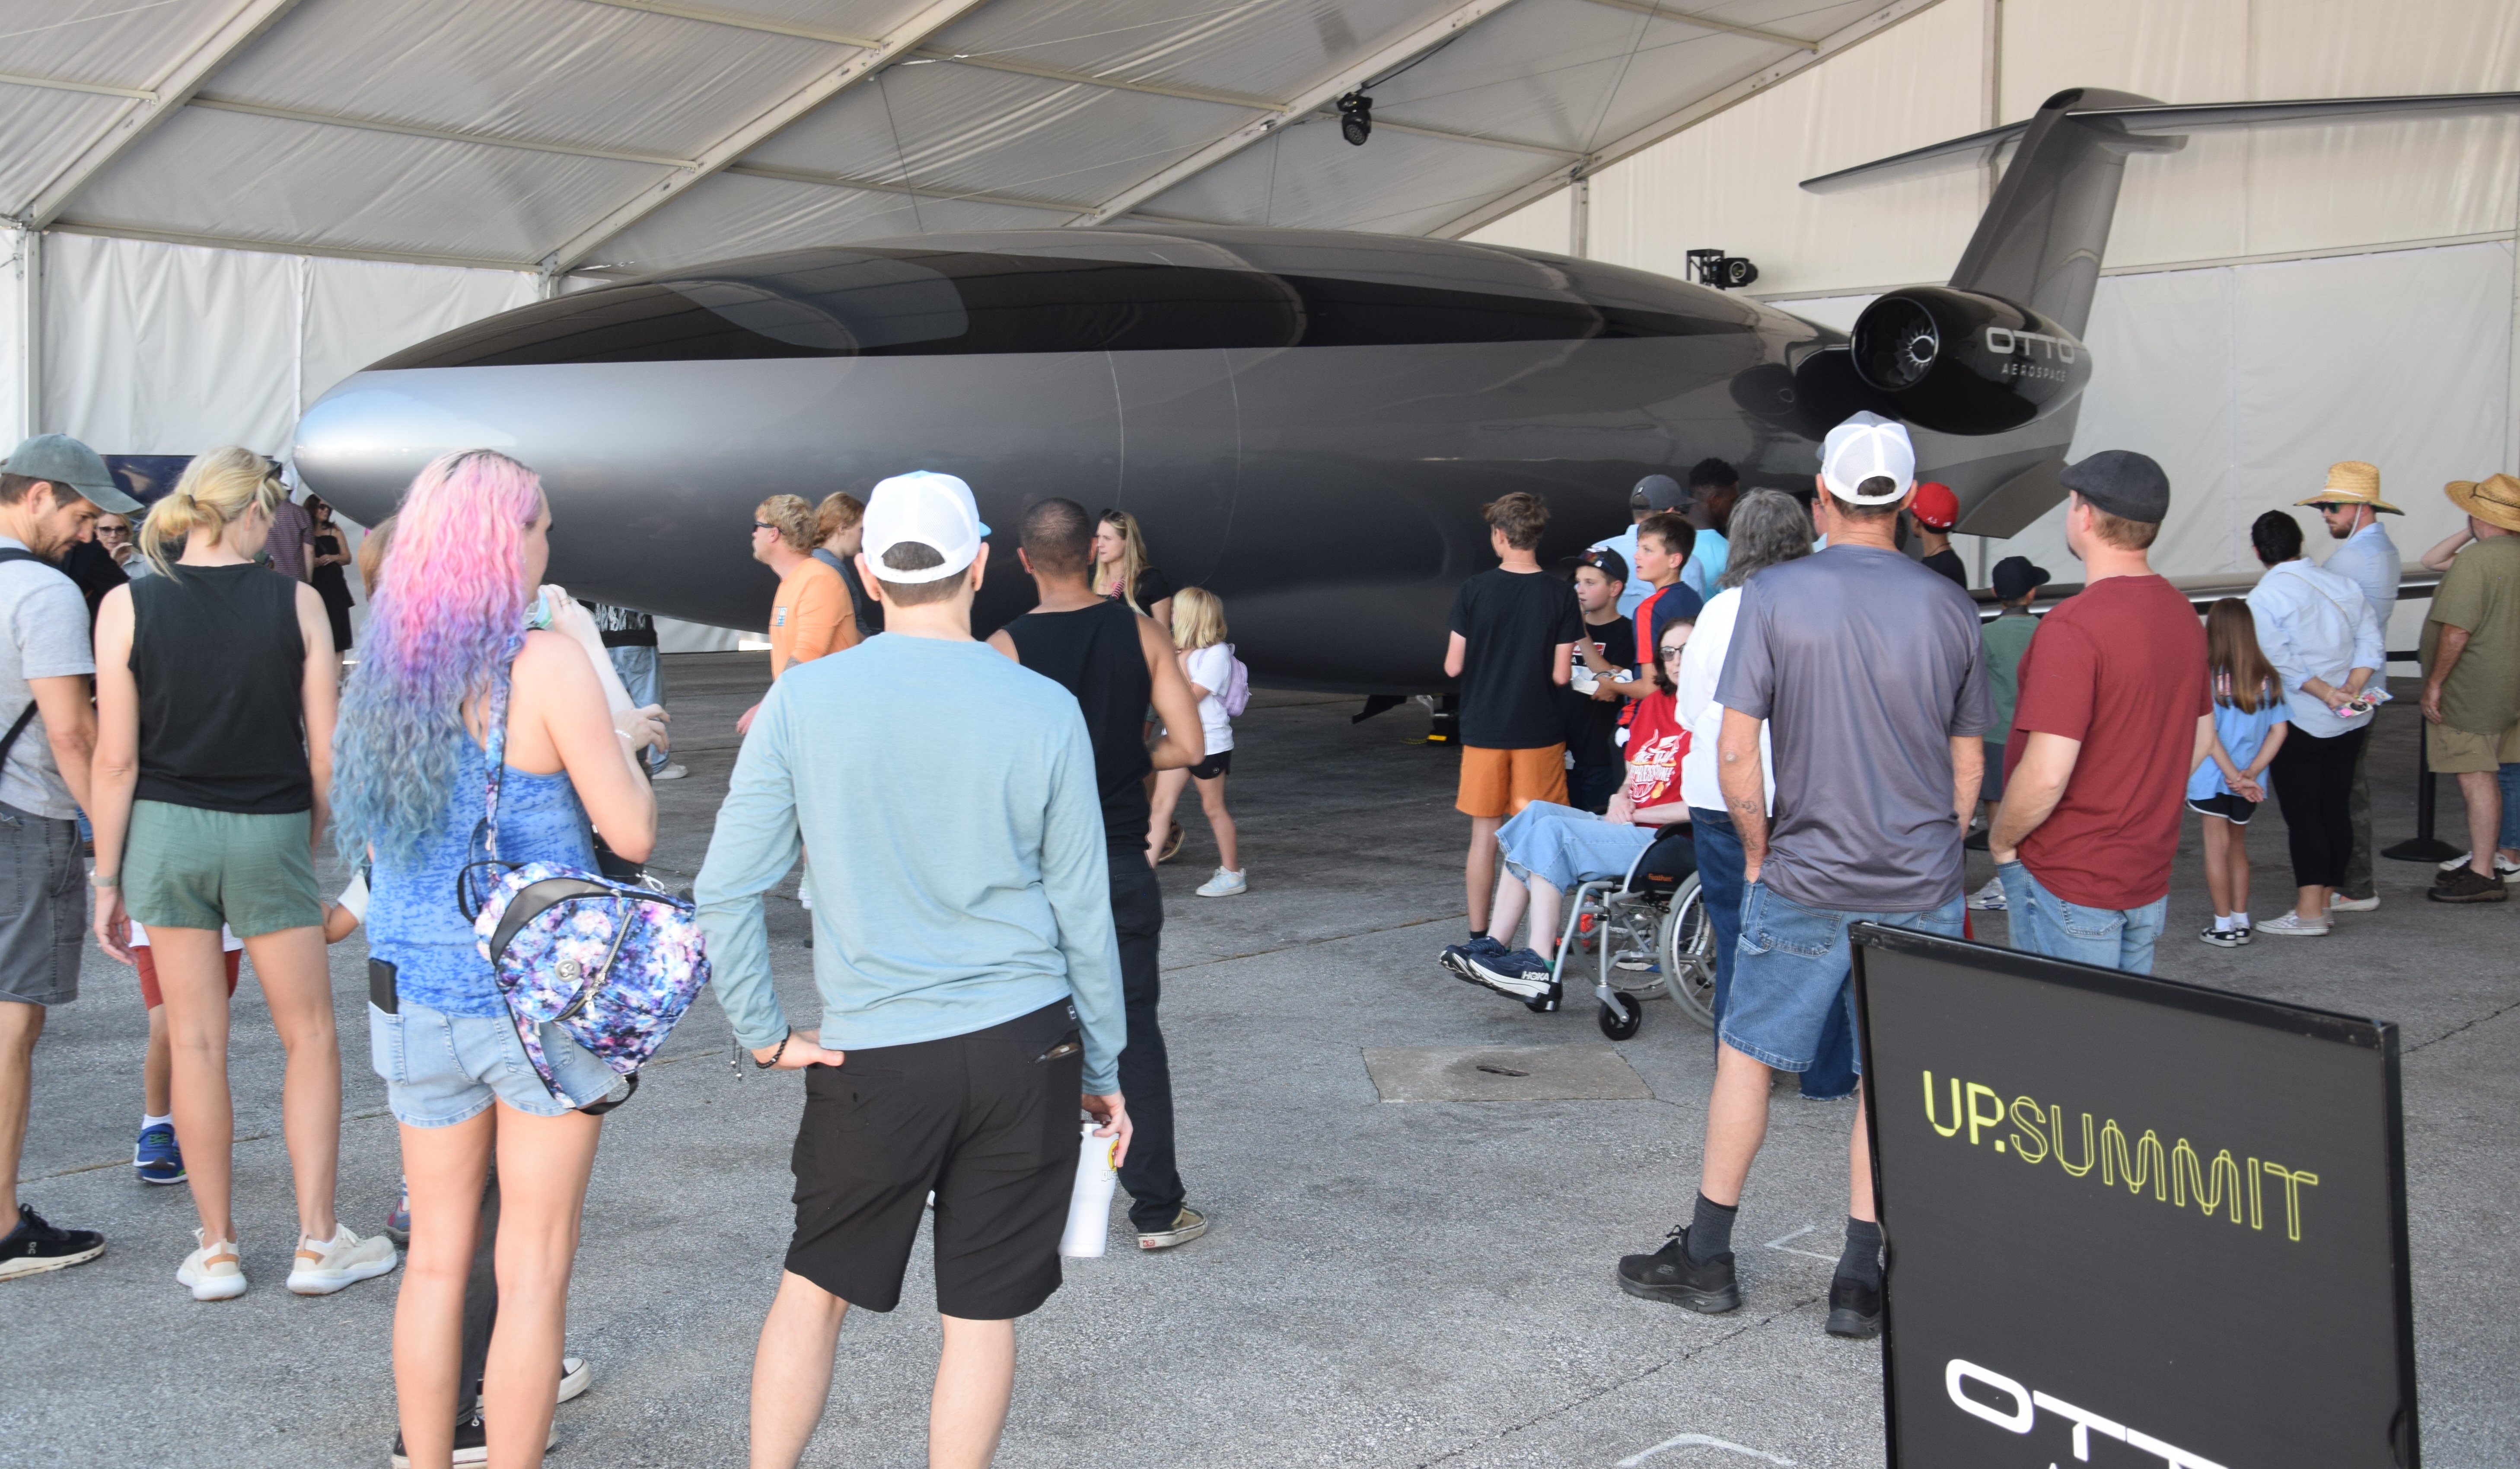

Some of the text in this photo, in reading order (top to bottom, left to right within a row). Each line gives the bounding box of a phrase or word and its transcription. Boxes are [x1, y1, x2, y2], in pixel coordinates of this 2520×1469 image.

[1986, 327, 2074, 363] OTTO
[2001, 363, 2066, 382] AEROSPACE
[1521, 971, 1549, 981] HOKA
[1946, 1359, 2229, 1469] OTT
